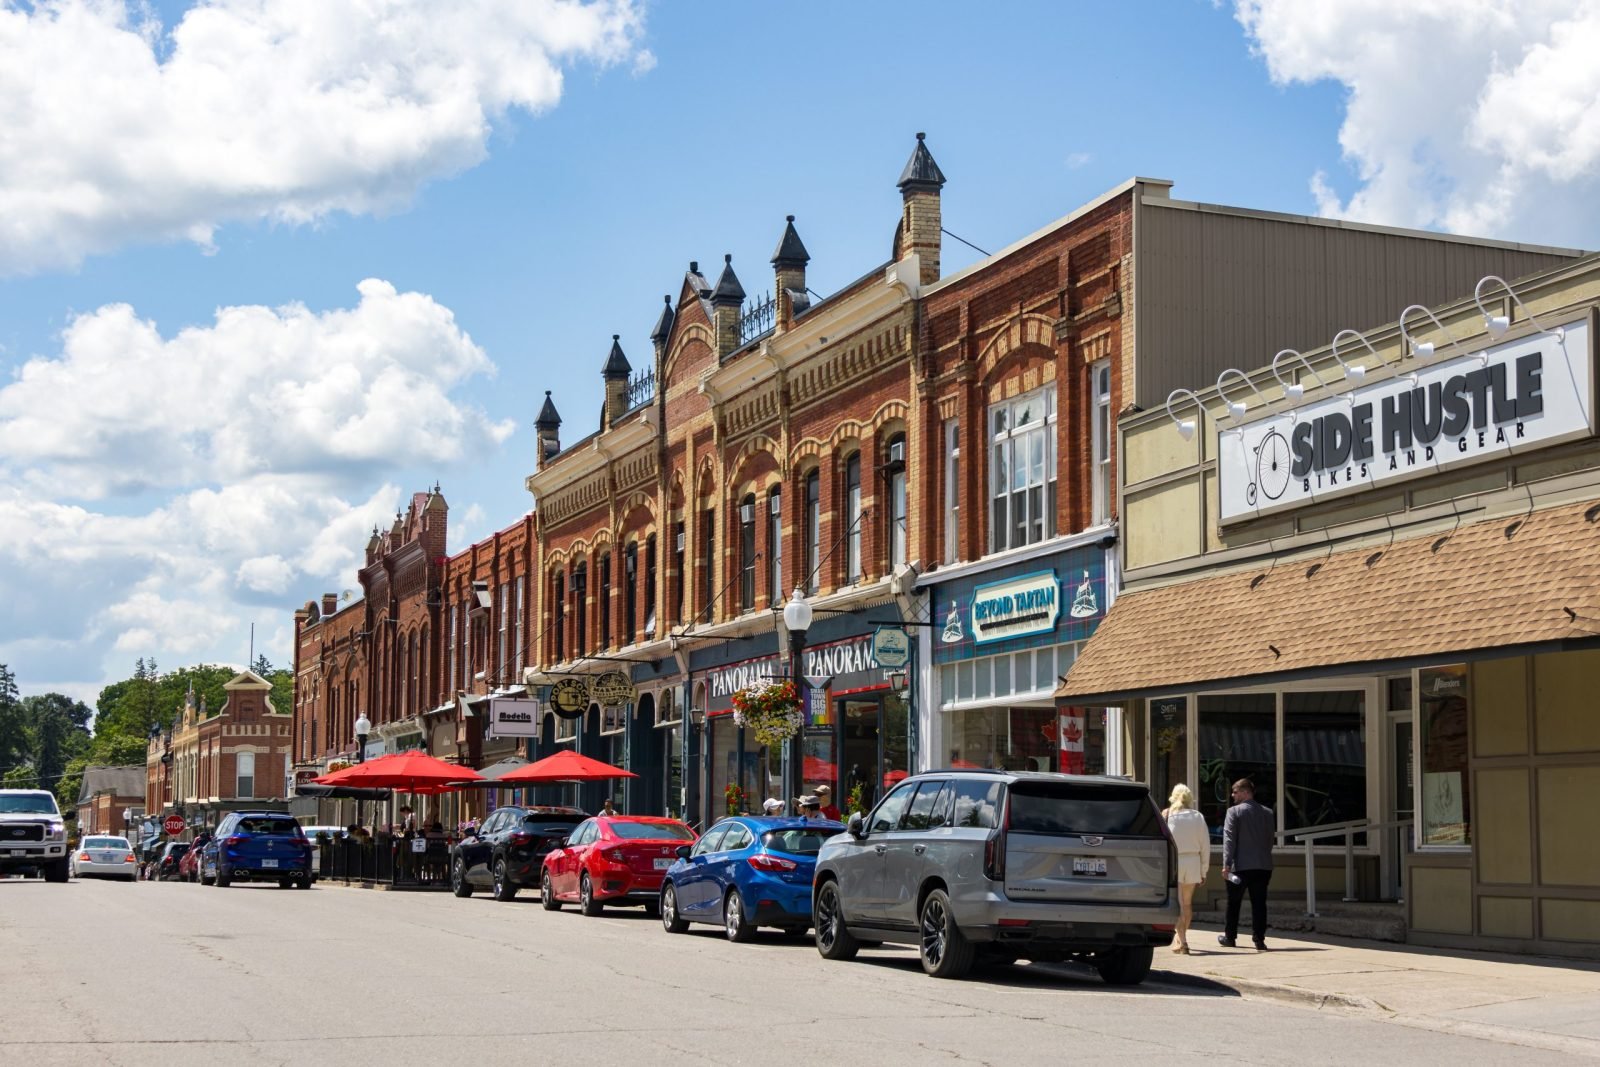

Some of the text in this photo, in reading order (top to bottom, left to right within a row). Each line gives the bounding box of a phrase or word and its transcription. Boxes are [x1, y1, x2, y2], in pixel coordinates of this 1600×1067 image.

[1291, 351, 1544, 477] SIDE HUSTLE
[1303, 422, 1525, 493] BIKES AND GEAR
[975, 586, 1055, 620] BEYOND TARTAN
[808, 642, 878, 677] PANORAM
[551, 679, 568, 701] PORT
[570, 679, 589, 712] SOCIAL
[811, 699, 826, 709] BIG
[499, 712, 531, 720] Modella
[165, 822, 184, 830] STOP
